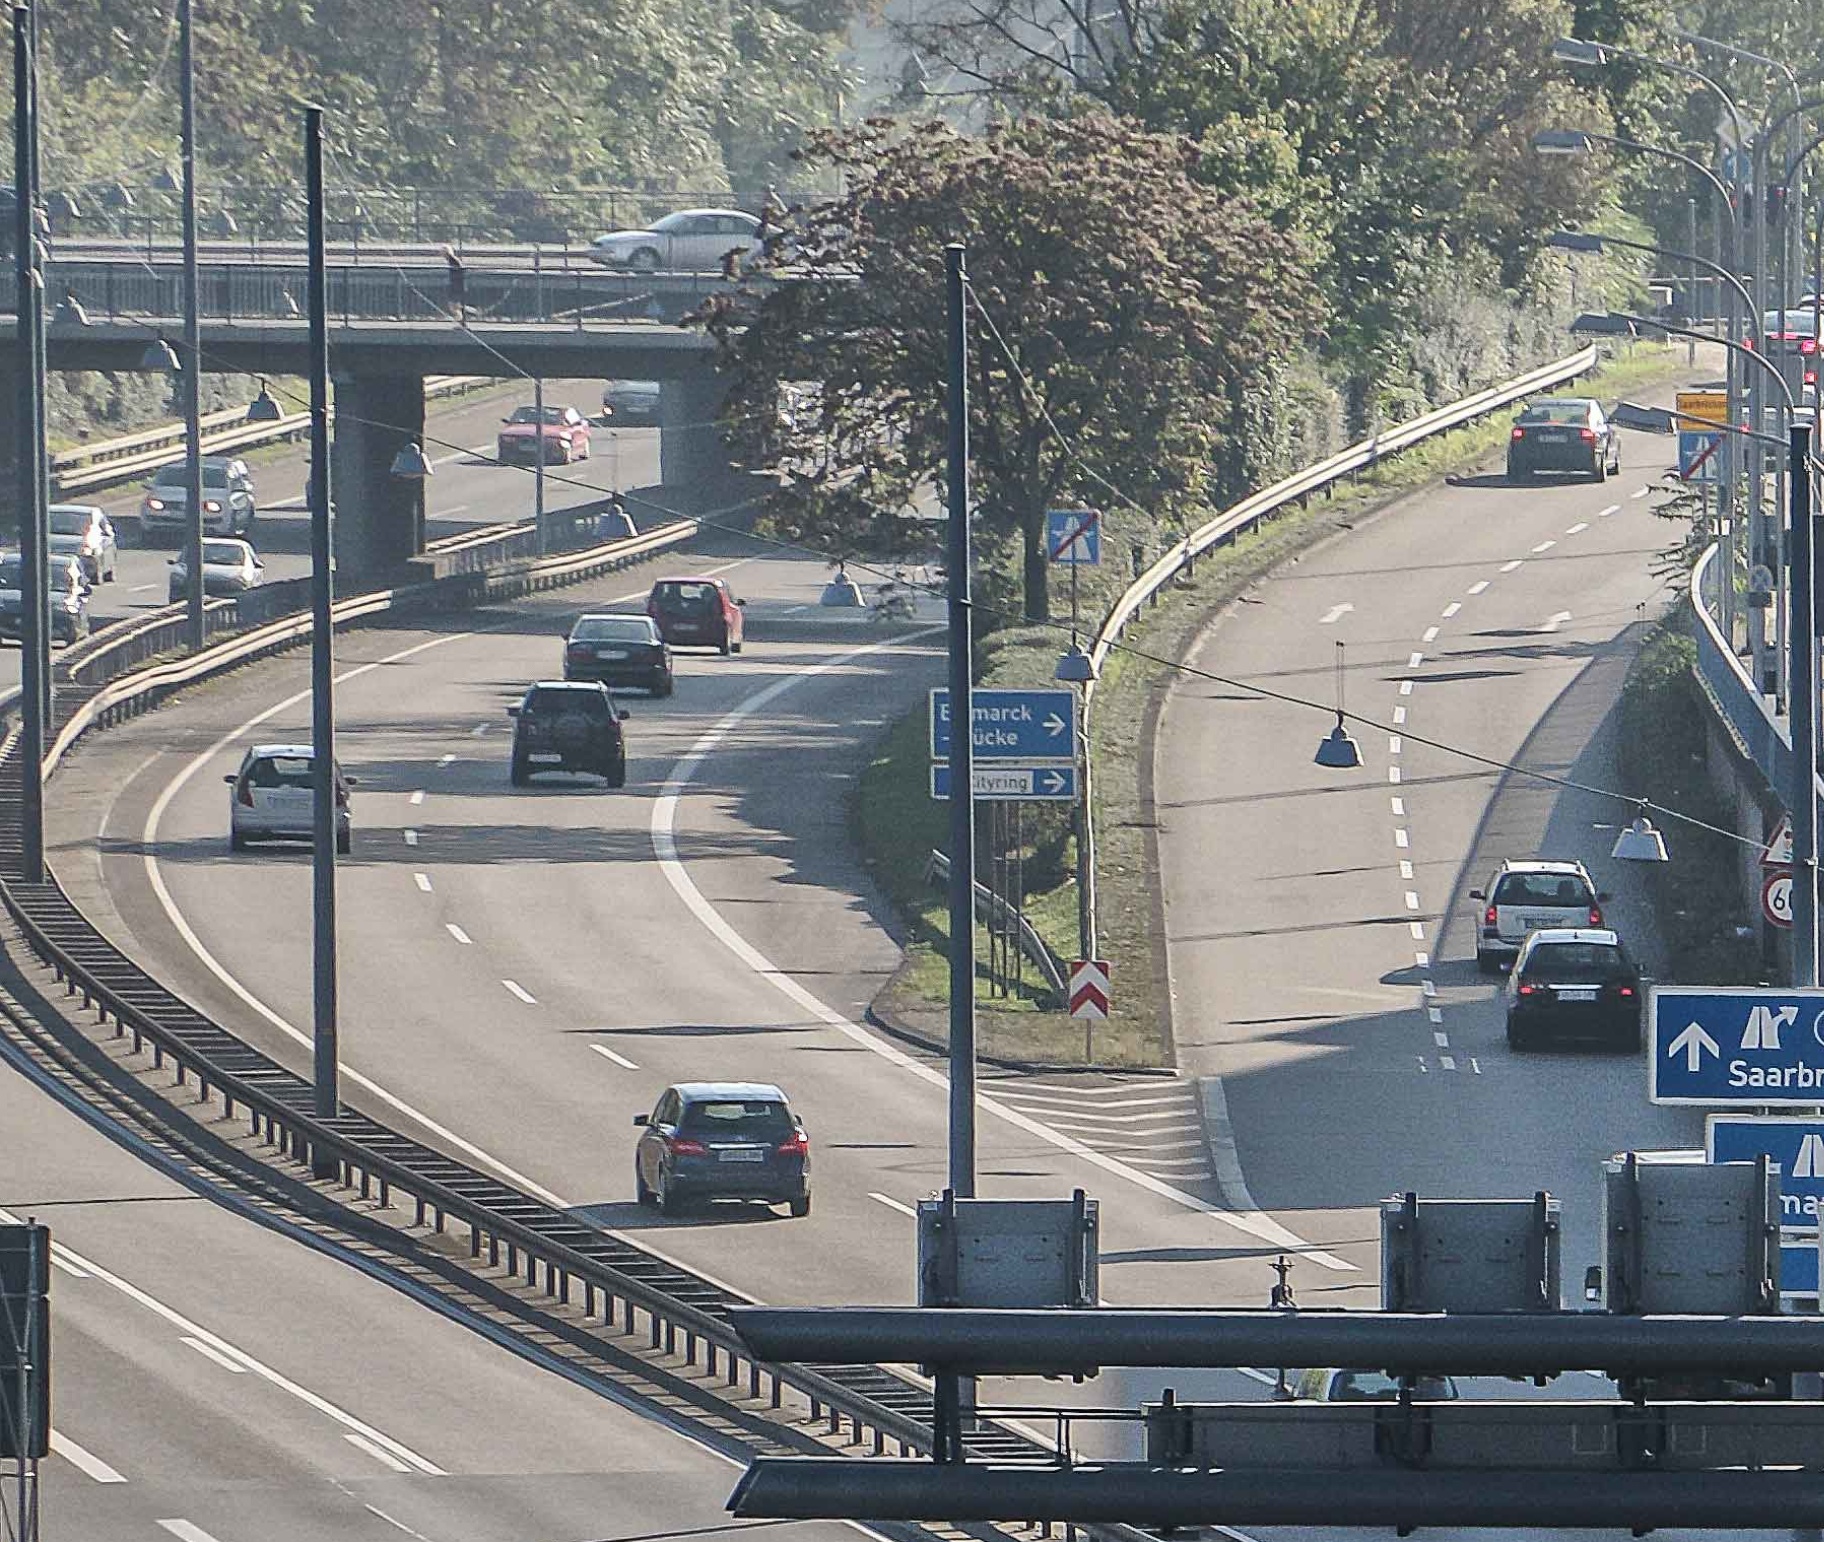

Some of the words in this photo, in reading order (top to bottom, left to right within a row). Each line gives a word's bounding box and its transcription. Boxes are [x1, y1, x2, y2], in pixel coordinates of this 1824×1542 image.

[939, 703, 1033, 722] Bmarck
[940, 728, 1018, 746] -ücke
[973, 774, 1028, 791] ityring
